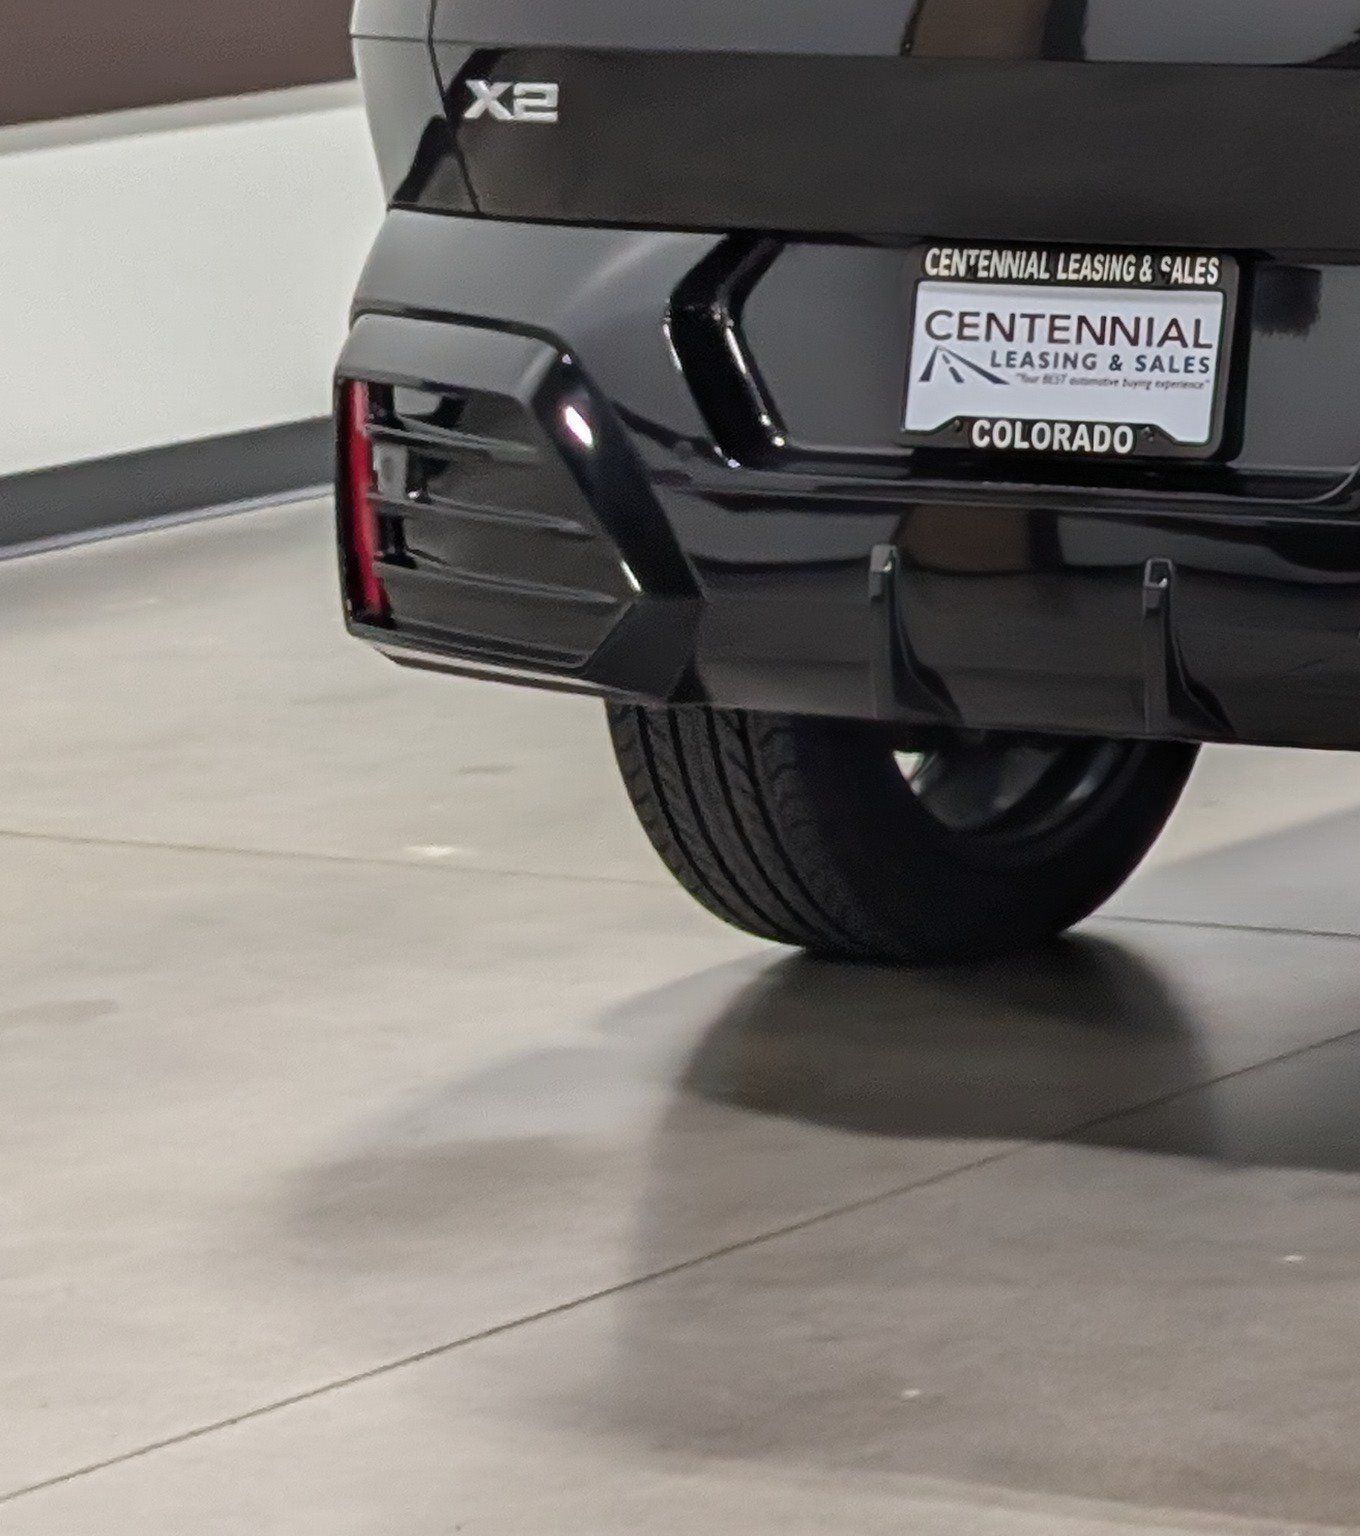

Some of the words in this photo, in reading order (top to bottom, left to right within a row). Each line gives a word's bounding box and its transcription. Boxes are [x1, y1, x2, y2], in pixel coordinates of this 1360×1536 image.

[464, 79, 559, 122] X2
[925, 248, 1050, 280] CENTENNIAL
[1057, 250, 1135, 282] LEASING
[1139, 255, 1153, 283] &
[1160, 256, 1220, 285] SALES
[924, 310, 1213, 349] CENTENNIAL
[990, 350, 1097, 371] LEASING
[1108, 354, 1123, 372] &
[1135, 355, 1210, 374] SALES
[972, 419, 1134, 454] COLORADO
